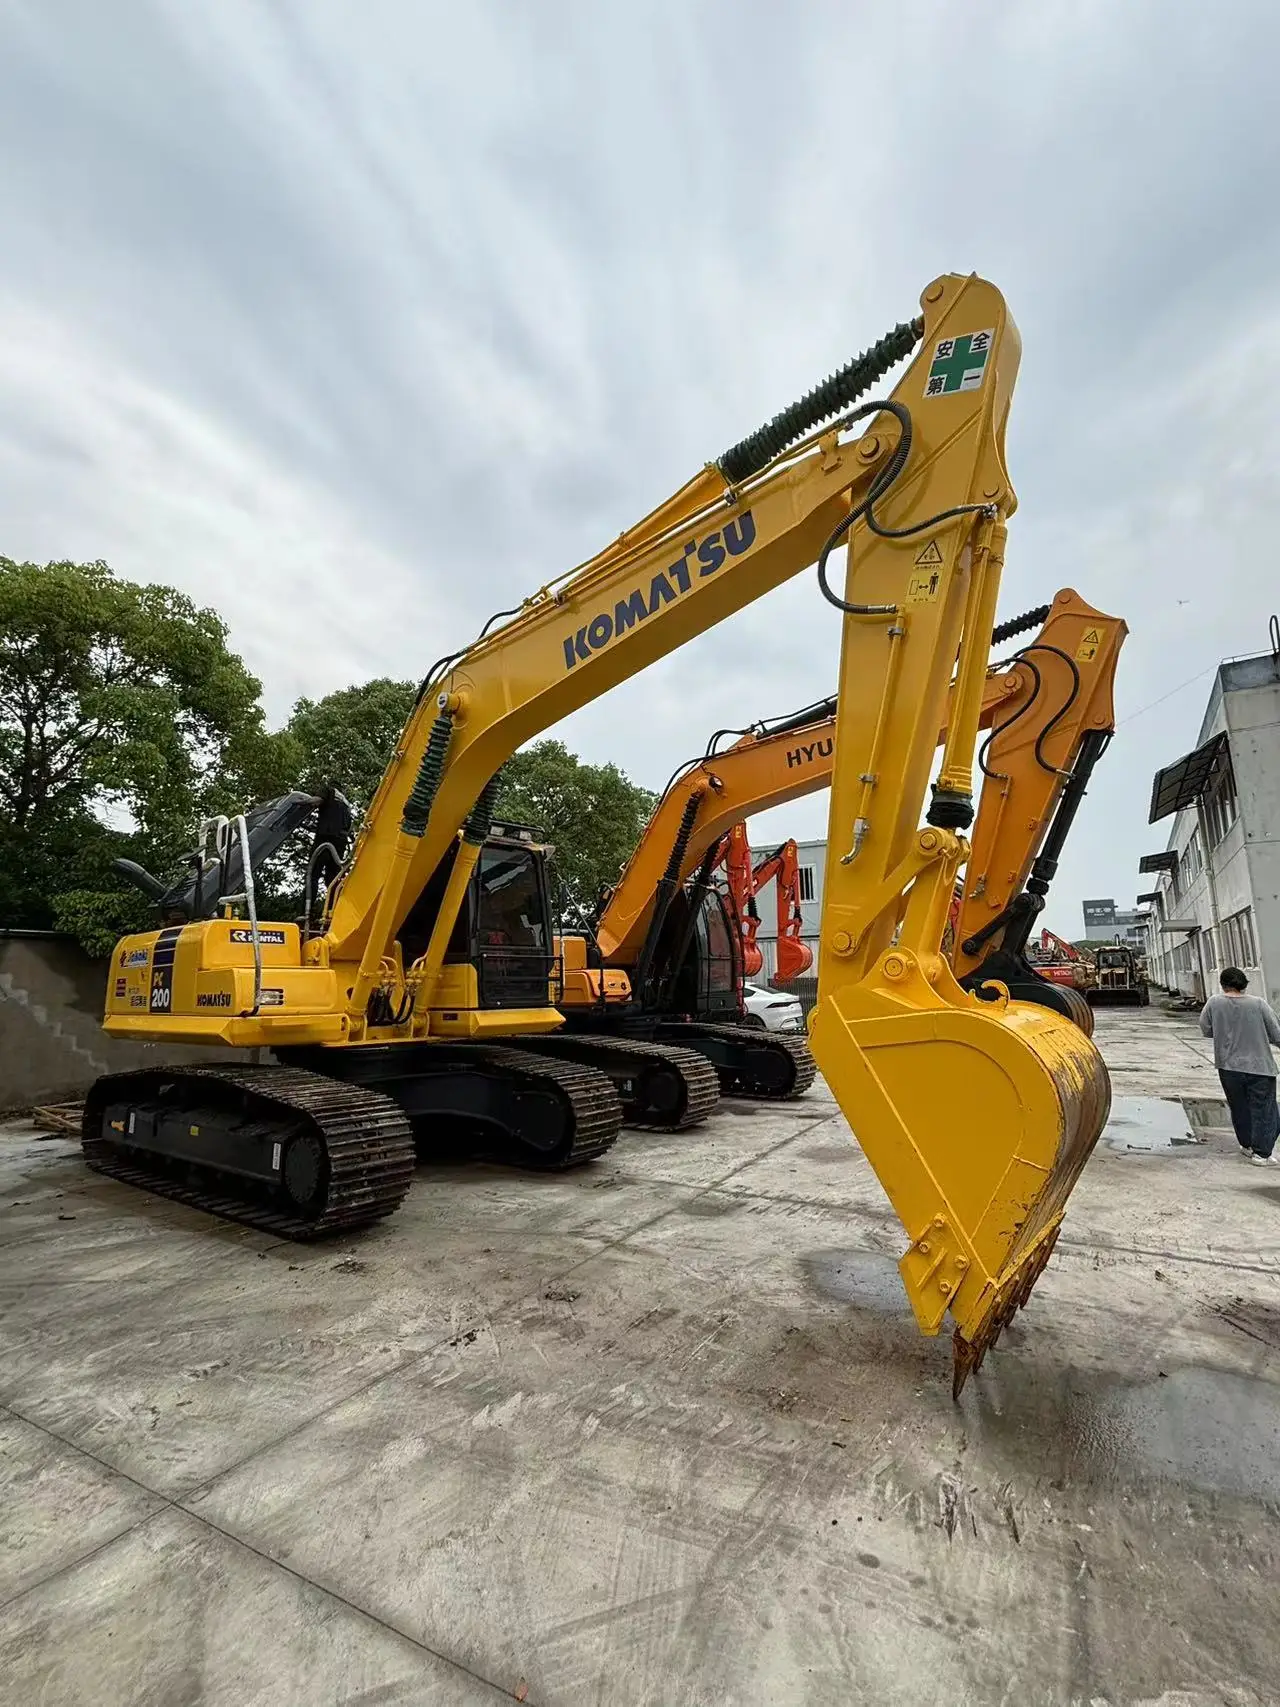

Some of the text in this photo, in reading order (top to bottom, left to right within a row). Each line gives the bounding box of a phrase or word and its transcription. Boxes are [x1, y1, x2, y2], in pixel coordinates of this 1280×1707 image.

[563, 509, 756, 670] KOMATSU
[786, 736, 836, 768] HYU
[247, 935, 284, 943] RNTAL
[151, 988, 170, 1007] 200
[196, 990, 232, 1007] KOMATSU
